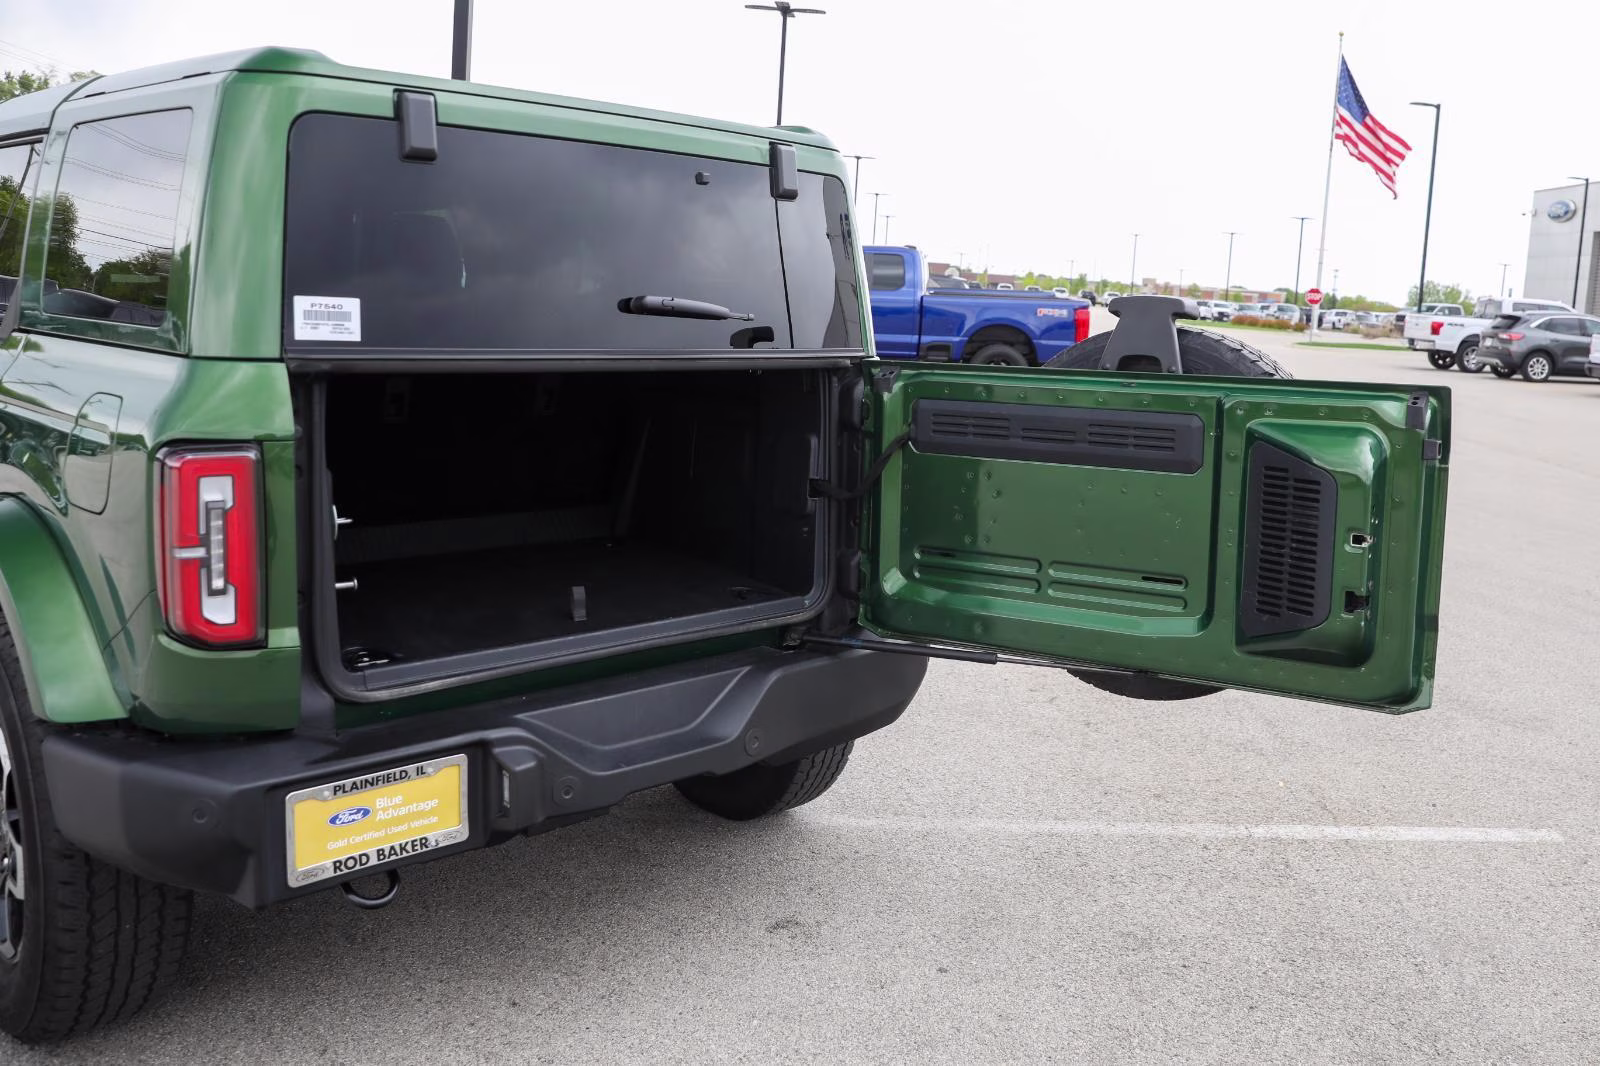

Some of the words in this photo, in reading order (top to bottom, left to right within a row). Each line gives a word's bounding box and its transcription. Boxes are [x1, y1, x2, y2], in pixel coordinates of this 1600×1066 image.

[416, 766, 426, 776] IL
[375, 794, 403, 809] Blue
[375, 798, 439, 822] Advantage
[335, 809, 365, 825] Ford
[327, 839, 348, 850] Gold
[350, 829, 386, 845] Certified
[387, 822, 409, 836] Used
[411, 816, 438, 828] Vehicle
[333, 856, 370, 874] ROD
[376, 836, 430, 862] BAKER
